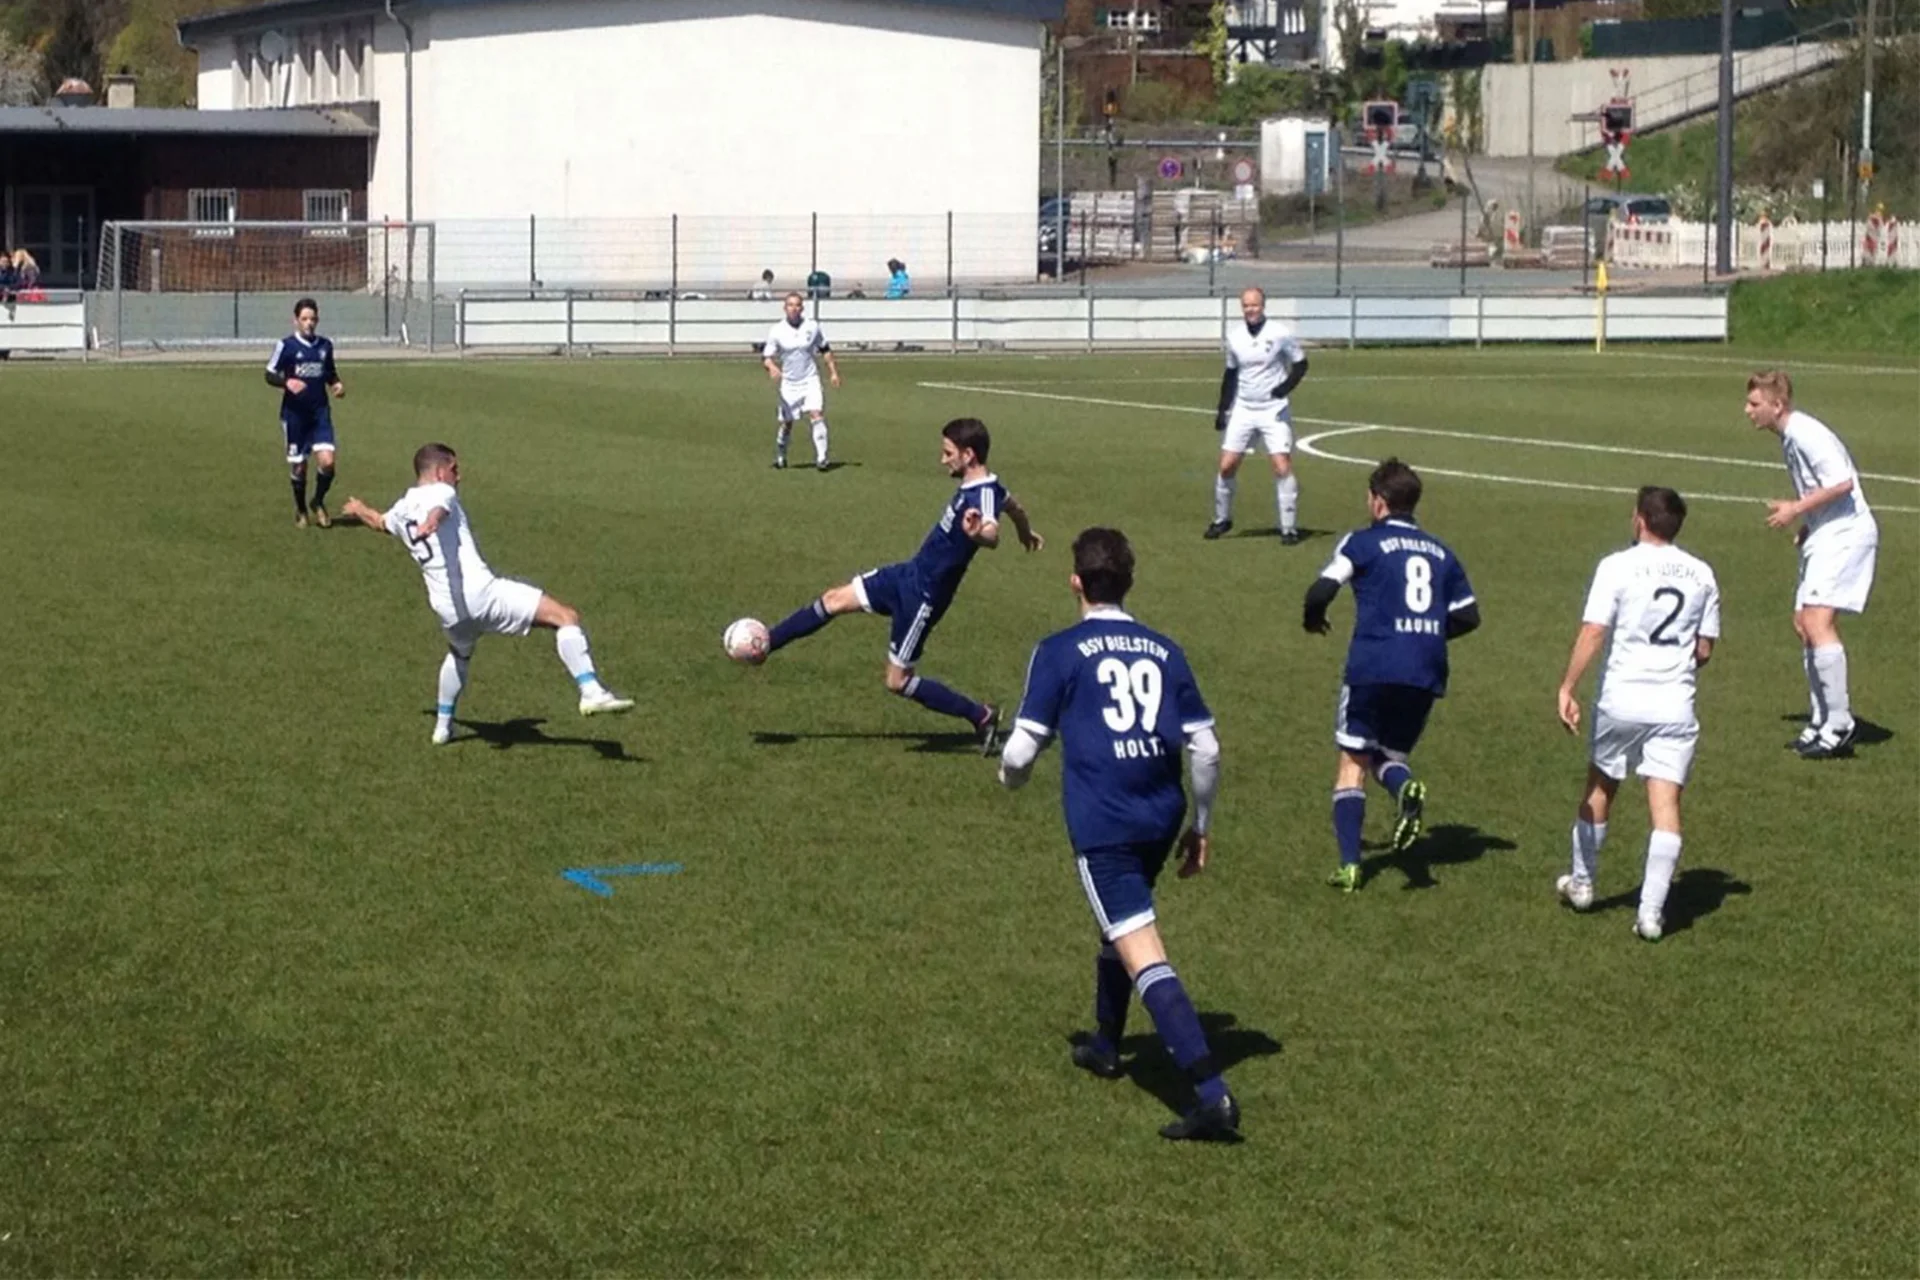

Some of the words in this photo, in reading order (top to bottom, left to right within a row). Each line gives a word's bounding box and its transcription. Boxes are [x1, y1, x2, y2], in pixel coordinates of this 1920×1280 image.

[405, 519, 434, 565] 5
[1405, 555, 1433, 613] 8
[1649, 586, 1685, 645] 2
[1077, 636, 1104, 658] BSV
[1104, 635, 1169, 662] BIELSTEIN
[1097, 657, 1163, 733] 39
